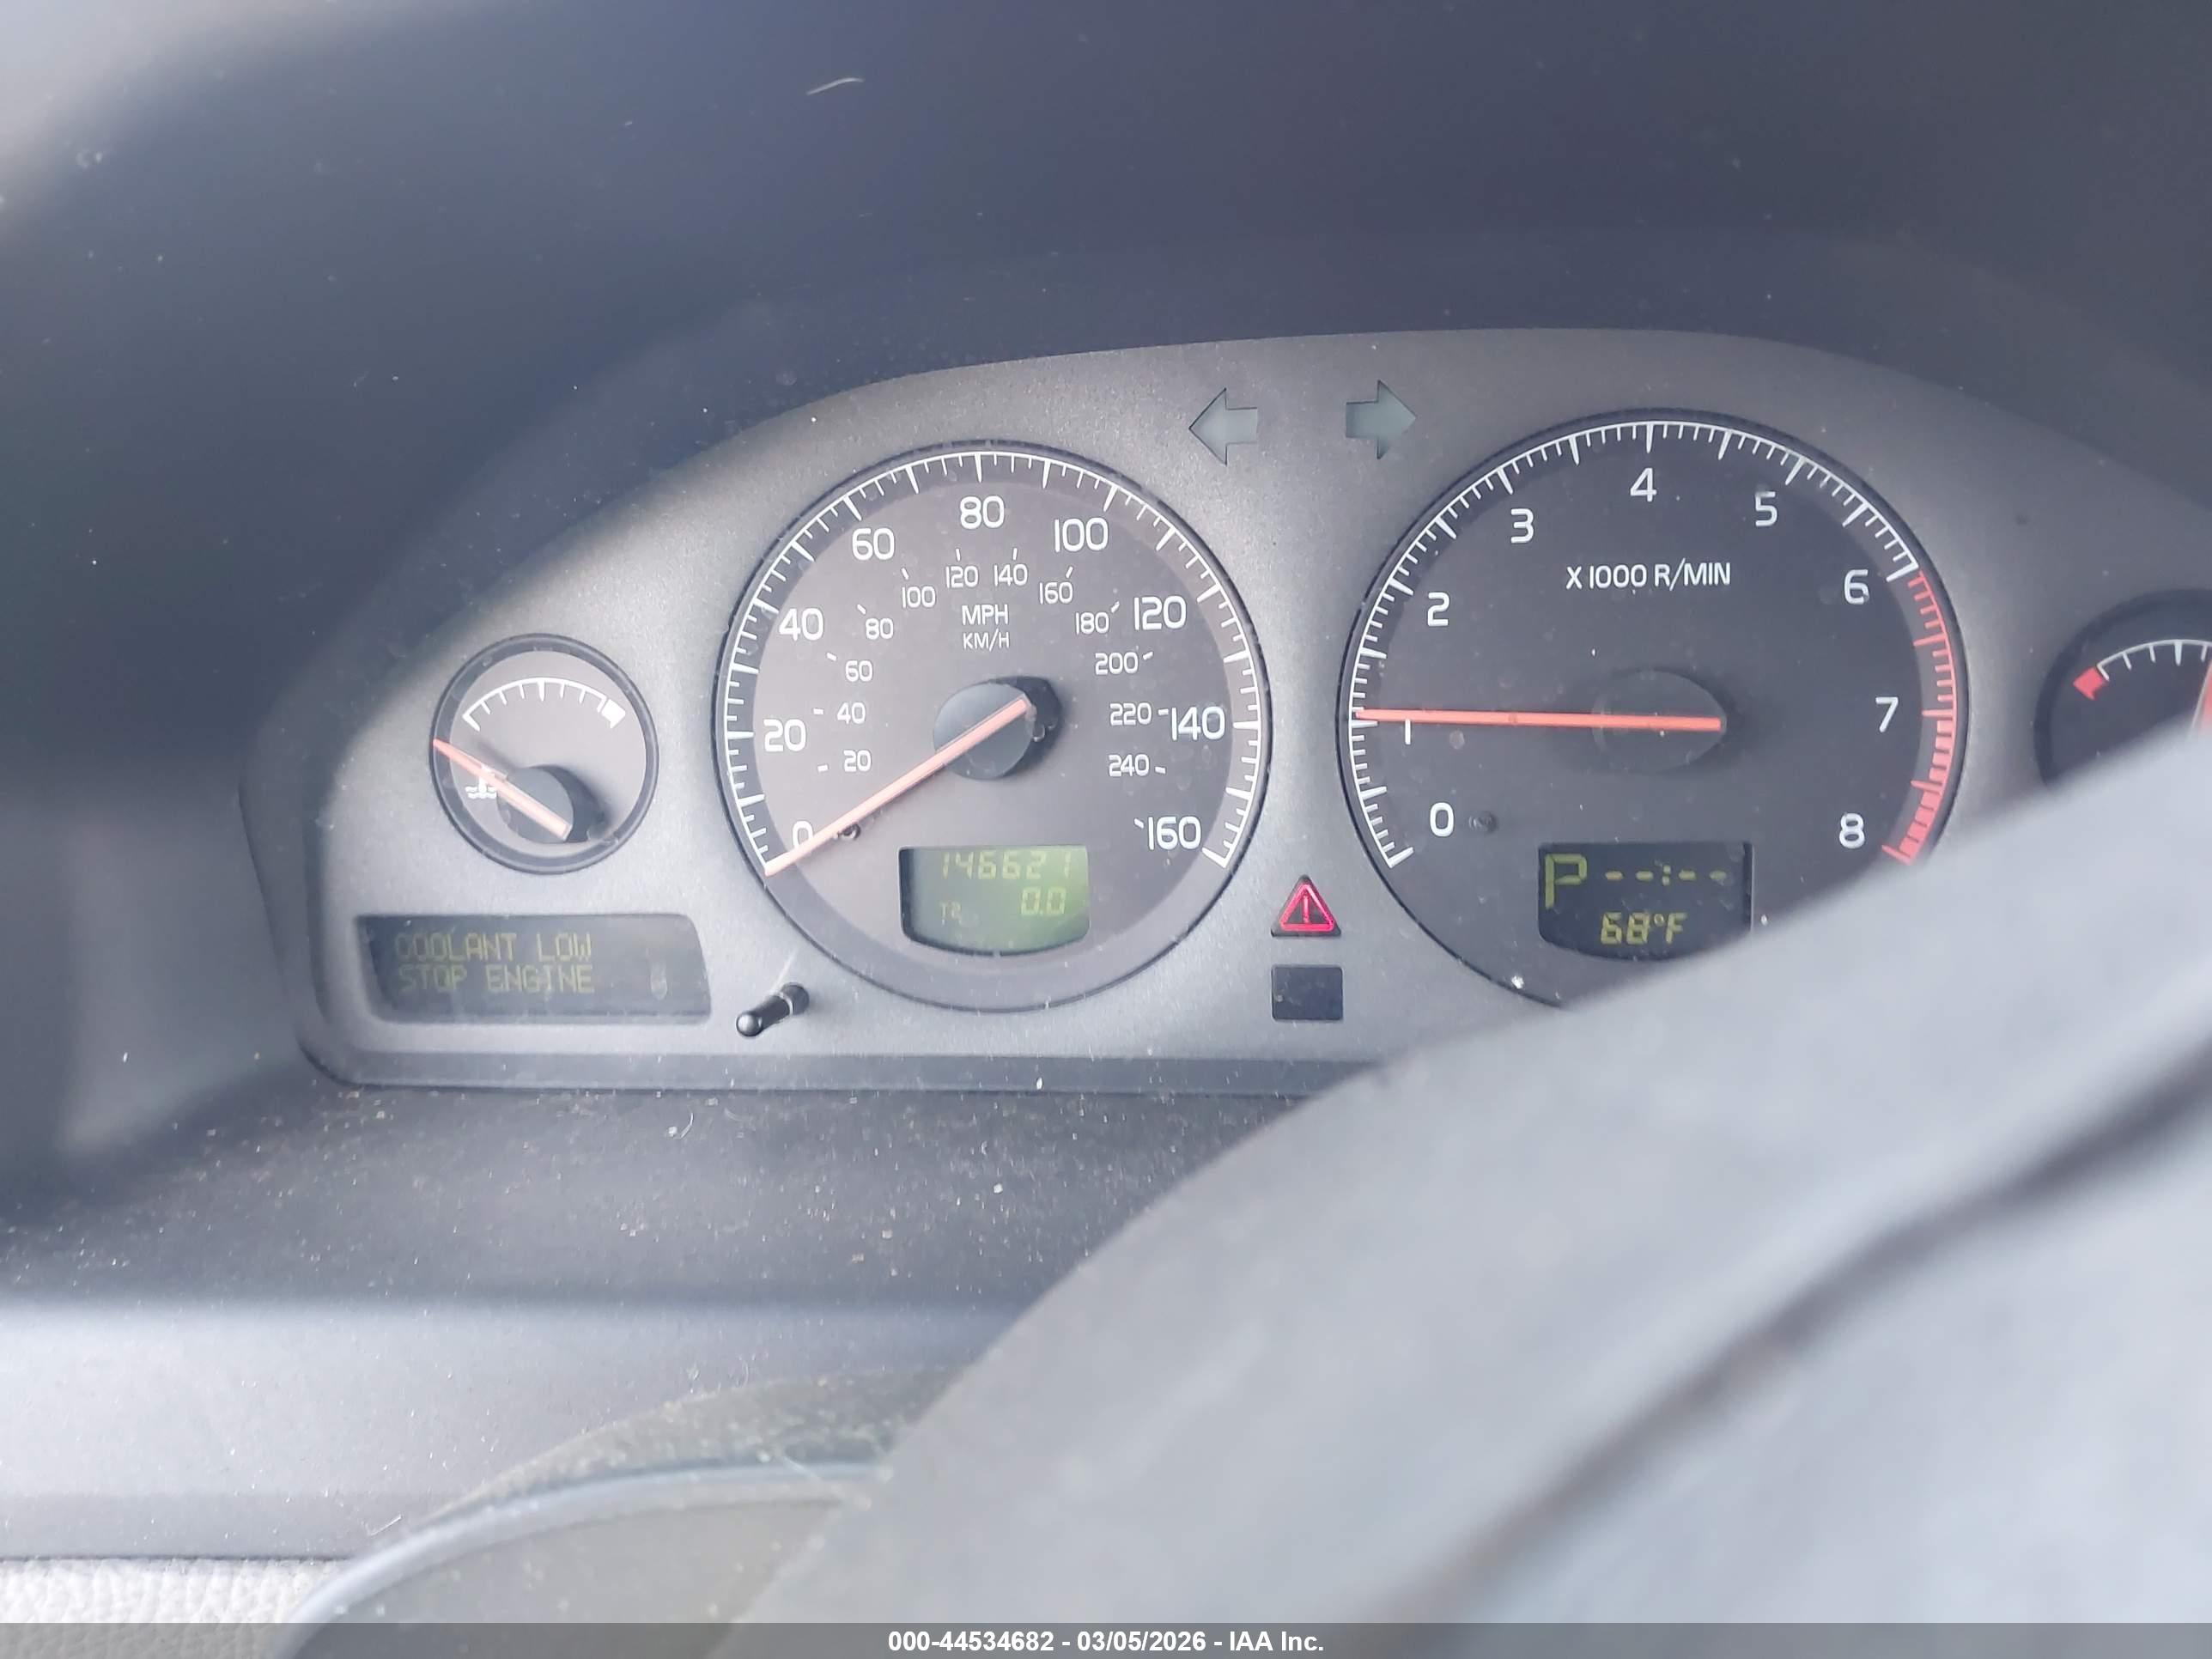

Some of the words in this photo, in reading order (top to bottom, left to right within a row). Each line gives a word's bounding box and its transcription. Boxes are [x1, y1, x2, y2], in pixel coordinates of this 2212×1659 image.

[1630, 468, 1656, 502] 4
[959, 495, 1006, 529] 80
[1754, 491, 1778, 527] 5
[1054, 517, 1109, 552] 100
[1510, 507, 1534, 543] 3
[852, 528, 895, 561] 60
[946, 566, 979, 588] 120
[994, 564, 1028, 586] 140
[1566, 566, 1582, 590] X
[1589, 563, 1647, 589] 1000
[1655, 558, 1731, 590] R/MIN
[1844, 568, 1869, 605] 6
[901, 586, 936, 608] 100
[1039, 581, 1073, 605] 160
[778, 608, 824, 641] 40
[962, 605, 1009, 627] MPH
[1075, 611, 1109, 634] 180
[1133, 596, 1186, 630] 120
[1427, 592, 1449, 627] 2
[866, 618, 894, 640] 80
[963, 631, 1010, 653] KM/H
[845, 660, 873, 682] 60
[1095, 652, 1139, 675] 200
[836, 702, 866, 724] 40
[1109, 702, 1152, 726] 220
[1170, 707, 1225, 741] 140
[1876, 696, 1899, 732] 7
[763, 719, 806, 751] 20
[843, 750, 872, 772] 20
[1109, 754, 1149, 776] 240
[792, 820, 815, 849] 0
[1148, 816, 1200, 851] 160
[1430, 803, 1454, 836] 0
[1838, 813, 1865, 848] 8
[943, 850, 1072, 879] 146621
[1546, 854, 1588, 908] P
[1021, 886, 1066, 916] 0.0
[395, 933, 516, 961] COOLANT
[536, 933, 592, 962] LOW
[398, 965, 467, 992] STOP
[486, 964, 594, 994] ENGINE
